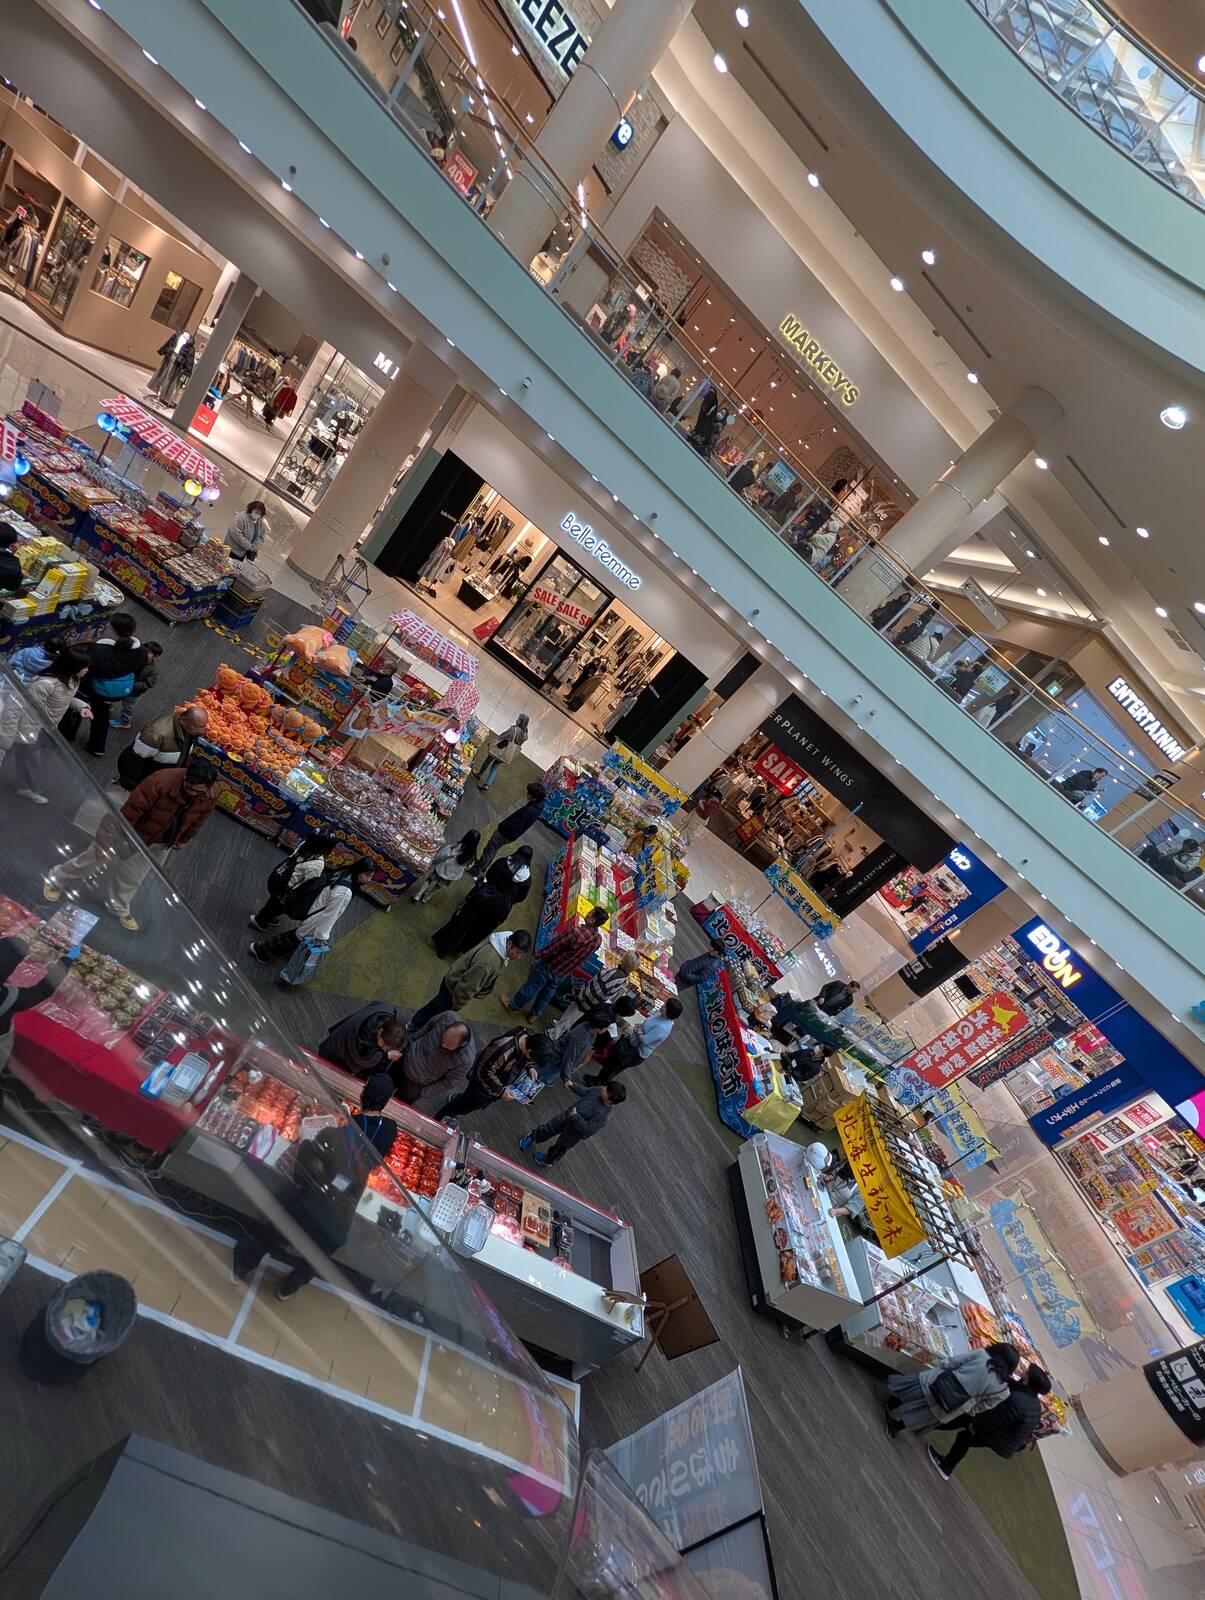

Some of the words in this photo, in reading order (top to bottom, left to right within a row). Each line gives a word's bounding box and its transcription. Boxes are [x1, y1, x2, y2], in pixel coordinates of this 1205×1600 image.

[516, 0, 588, 78] EEZE
[779, 313, 861, 408] MARKEY'S
[561, 513, 597, 550] Belle
[593, 542, 642, 590] Femme
[533, 586, 558, 605] SALE
[556, 600, 580, 619] SALE
[761, 751, 801, 789] SALE
[820, 755, 854, 787] WINGS
[1026, 923, 1082, 988] EDION
[705, 1000, 743, 1097] 北の味覚市
[1045, 1101, 1079, 1126] エディオン
[838, 1112, 902, 1244] 北海生珍味
